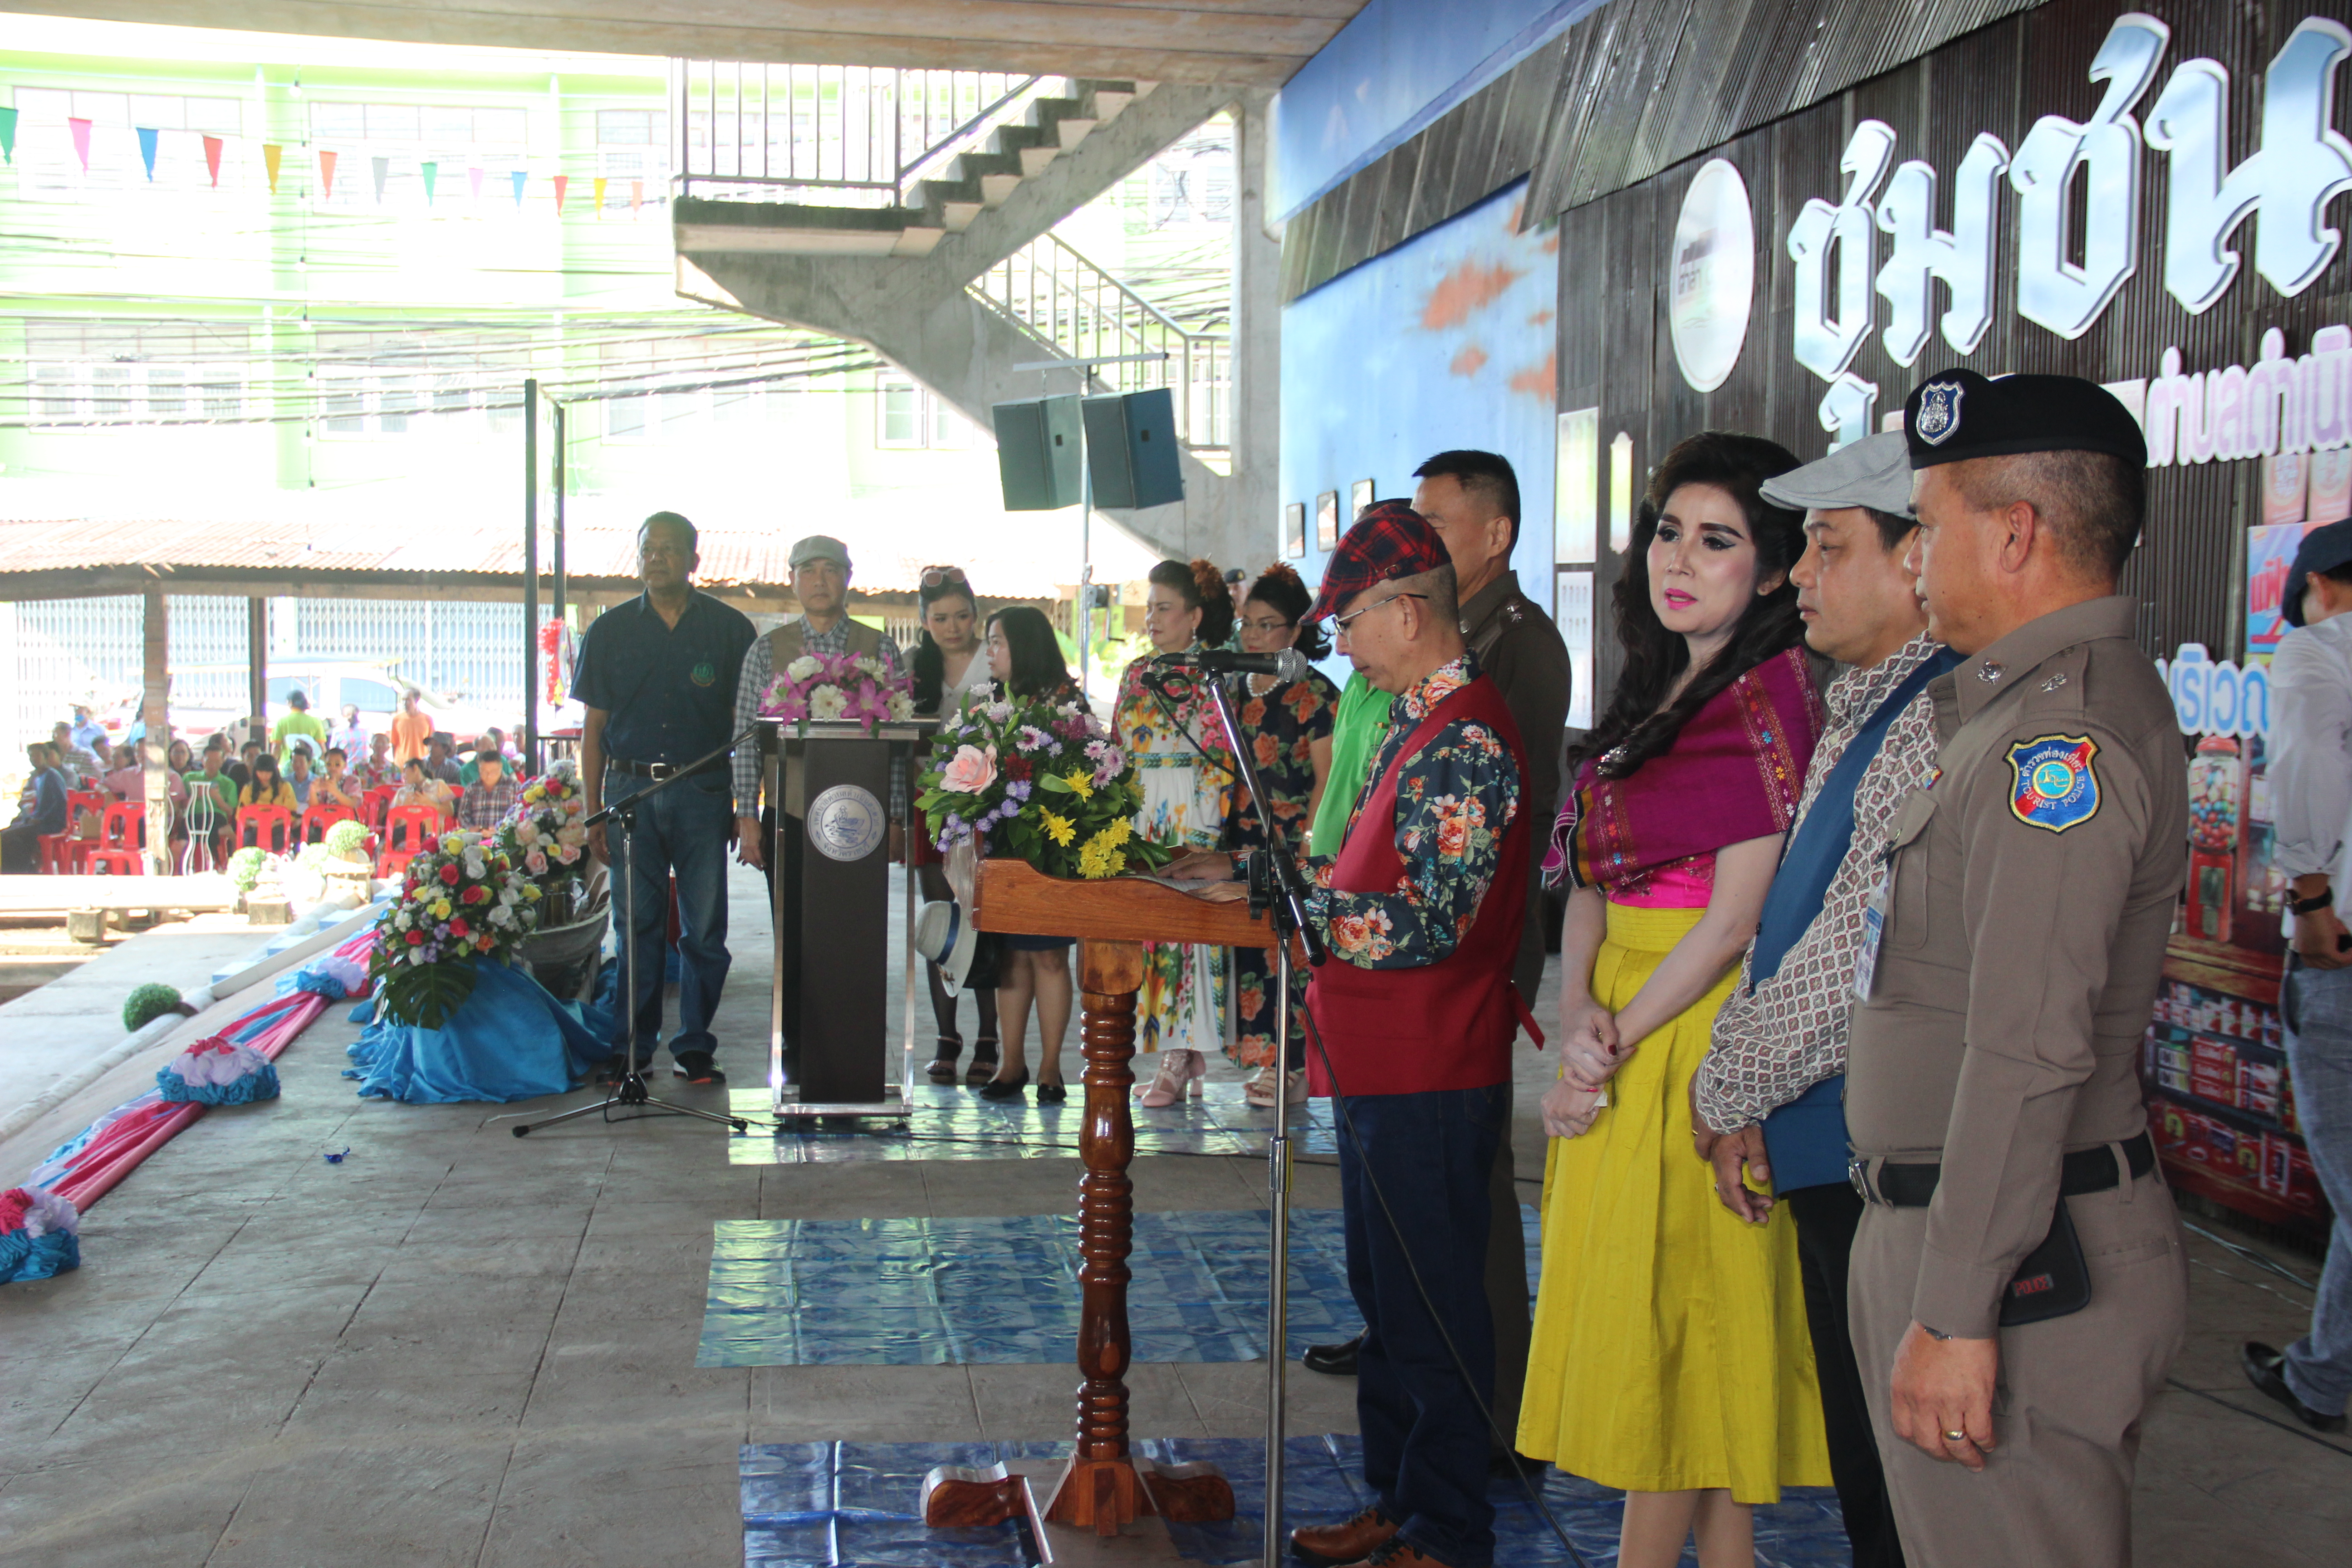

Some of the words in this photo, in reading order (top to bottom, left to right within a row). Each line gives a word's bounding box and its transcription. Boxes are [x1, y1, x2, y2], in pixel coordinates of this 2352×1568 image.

[2146, 326, 2352, 466] ตำบลดำเนิ
[2019, 746, 2084, 777] ตำรวจท่องเที่ยว
[2021, 780, 2057, 810] TOURIST
[2061, 776, 2085, 807] POLICE
[2014, 1275, 2049, 1296] POLICE
